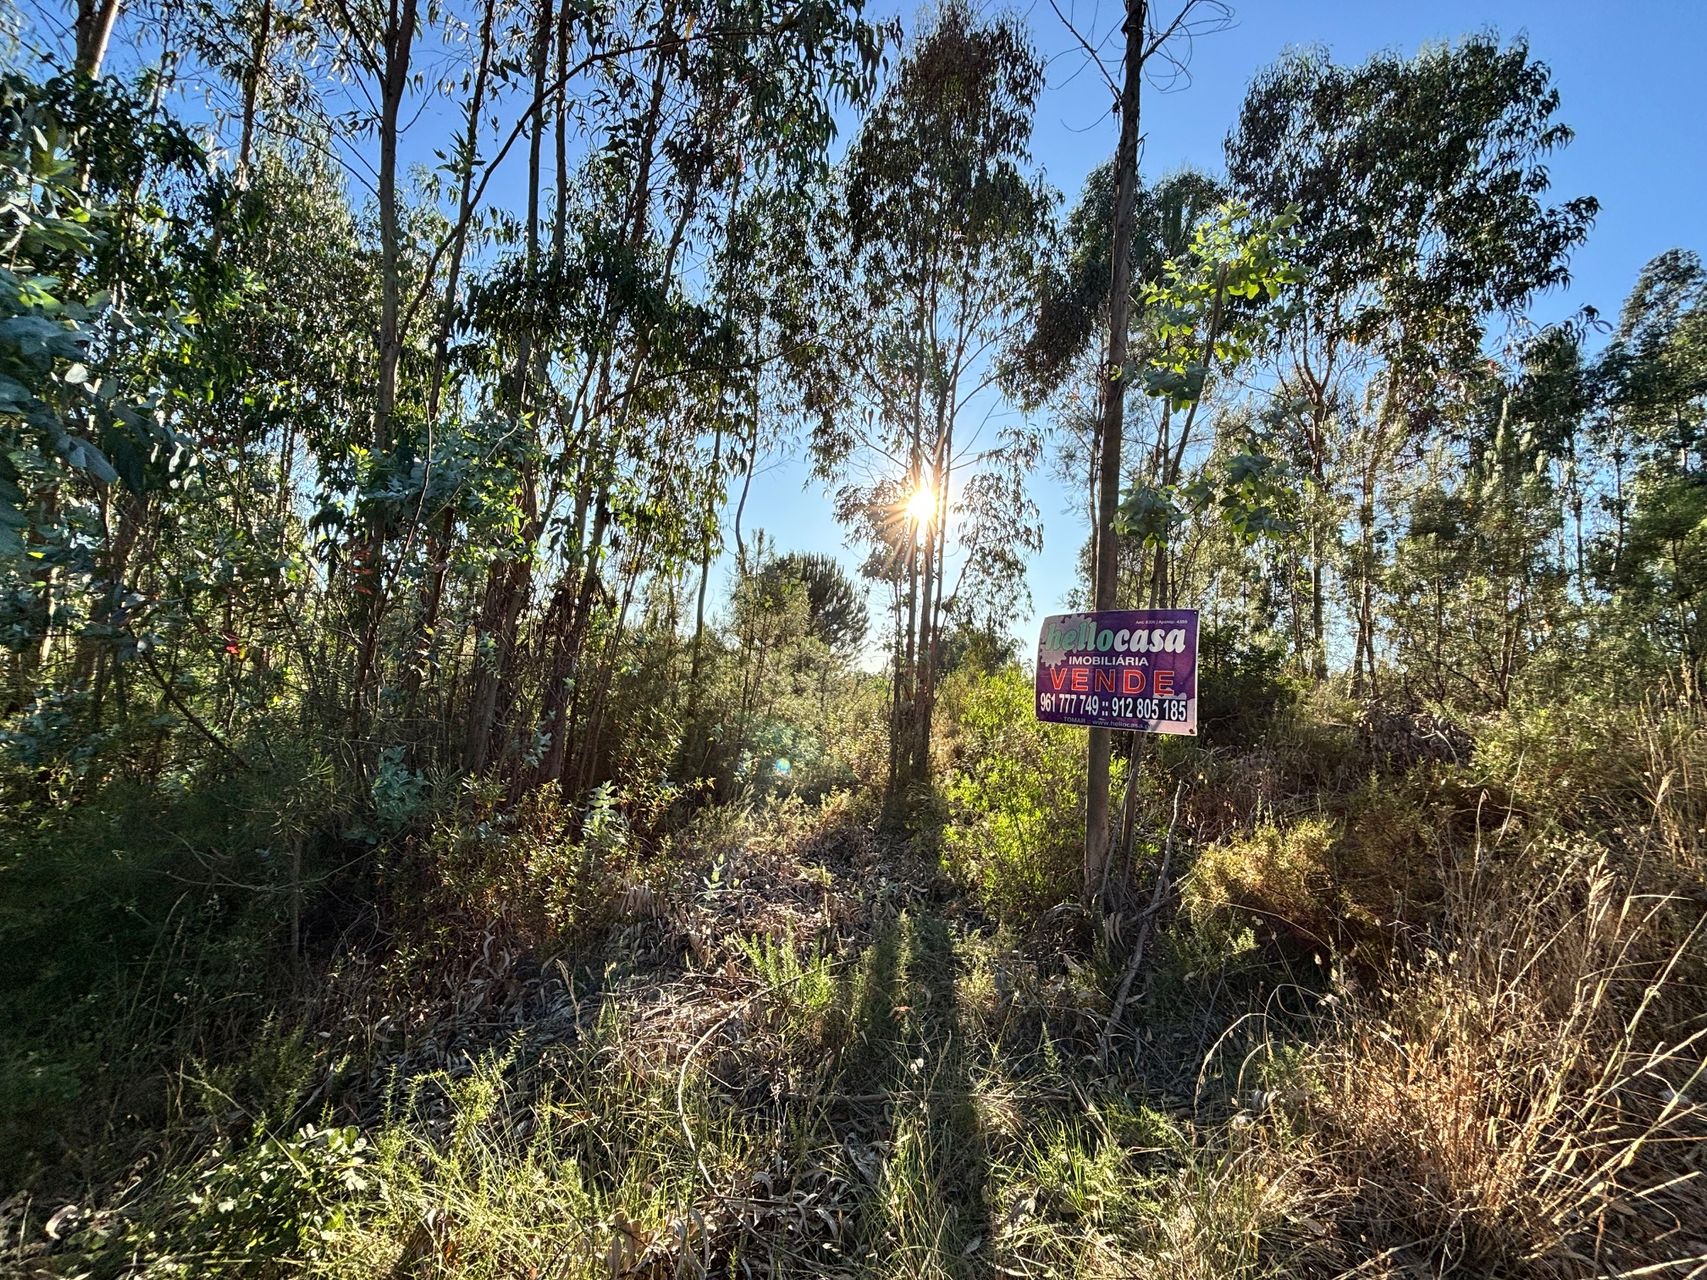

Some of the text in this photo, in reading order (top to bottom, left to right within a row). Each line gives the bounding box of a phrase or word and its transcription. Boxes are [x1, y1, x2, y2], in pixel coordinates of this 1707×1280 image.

[1046, 621, 1186, 653] hellocasa
[1068, 654, 1149, 666] IMOBILIÁRIA
[1050, 668, 1174, 696] VENDE
[1040, 693, 1056, 712] 961
[1059, 694, 1077, 714] 777
[1080, 695, 1099, 716] 749
[1112, 697, 1133, 718] 912
[1136, 698, 1159, 719] 805
[1162, 699, 1187, 720] 185
